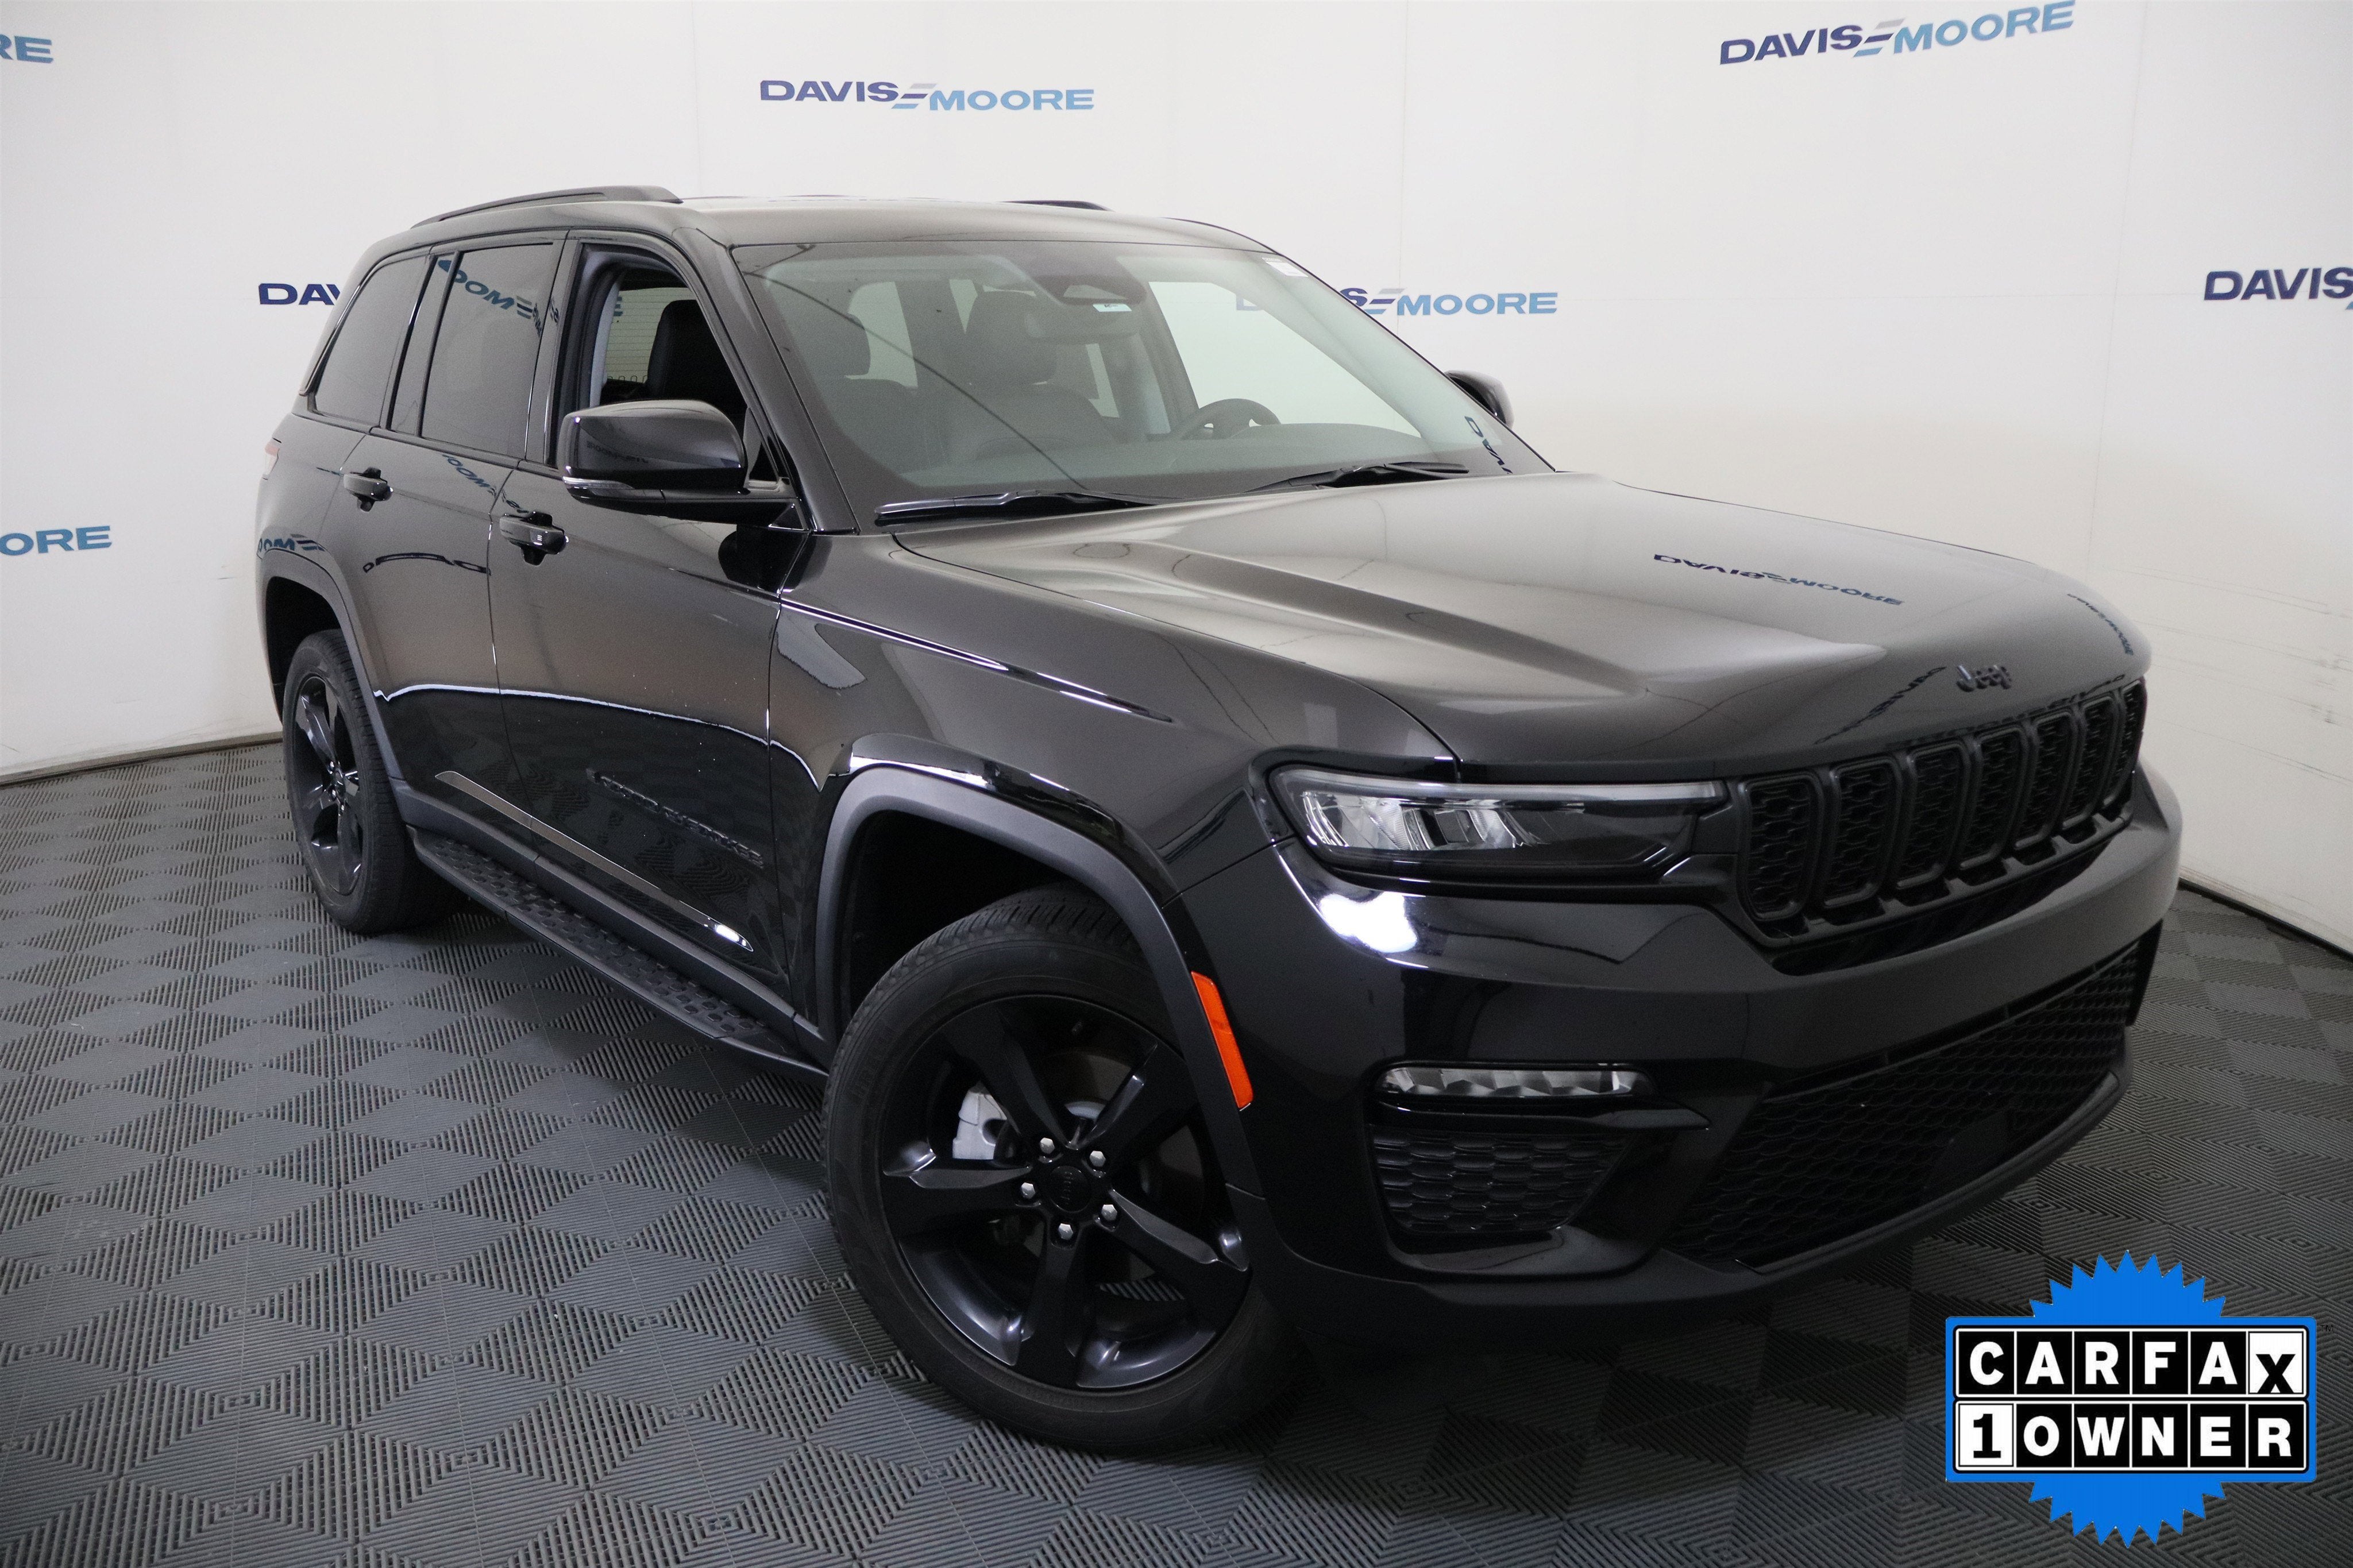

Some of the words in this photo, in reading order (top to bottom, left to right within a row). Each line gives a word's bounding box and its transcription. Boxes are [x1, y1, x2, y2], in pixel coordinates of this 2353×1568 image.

[1720, 24, 1863, 65] DAVIS
[1893, 0, 2076, 55] MOORE
[760, 80, 899, 102] DAVIS
[929, 89, 1094, 111] MOORE
[2204, 267, 2353, 300] DAVIS
[1397, 292, 1558, 316] MOORE
[1956, 664, 2012, 692] Jeep
